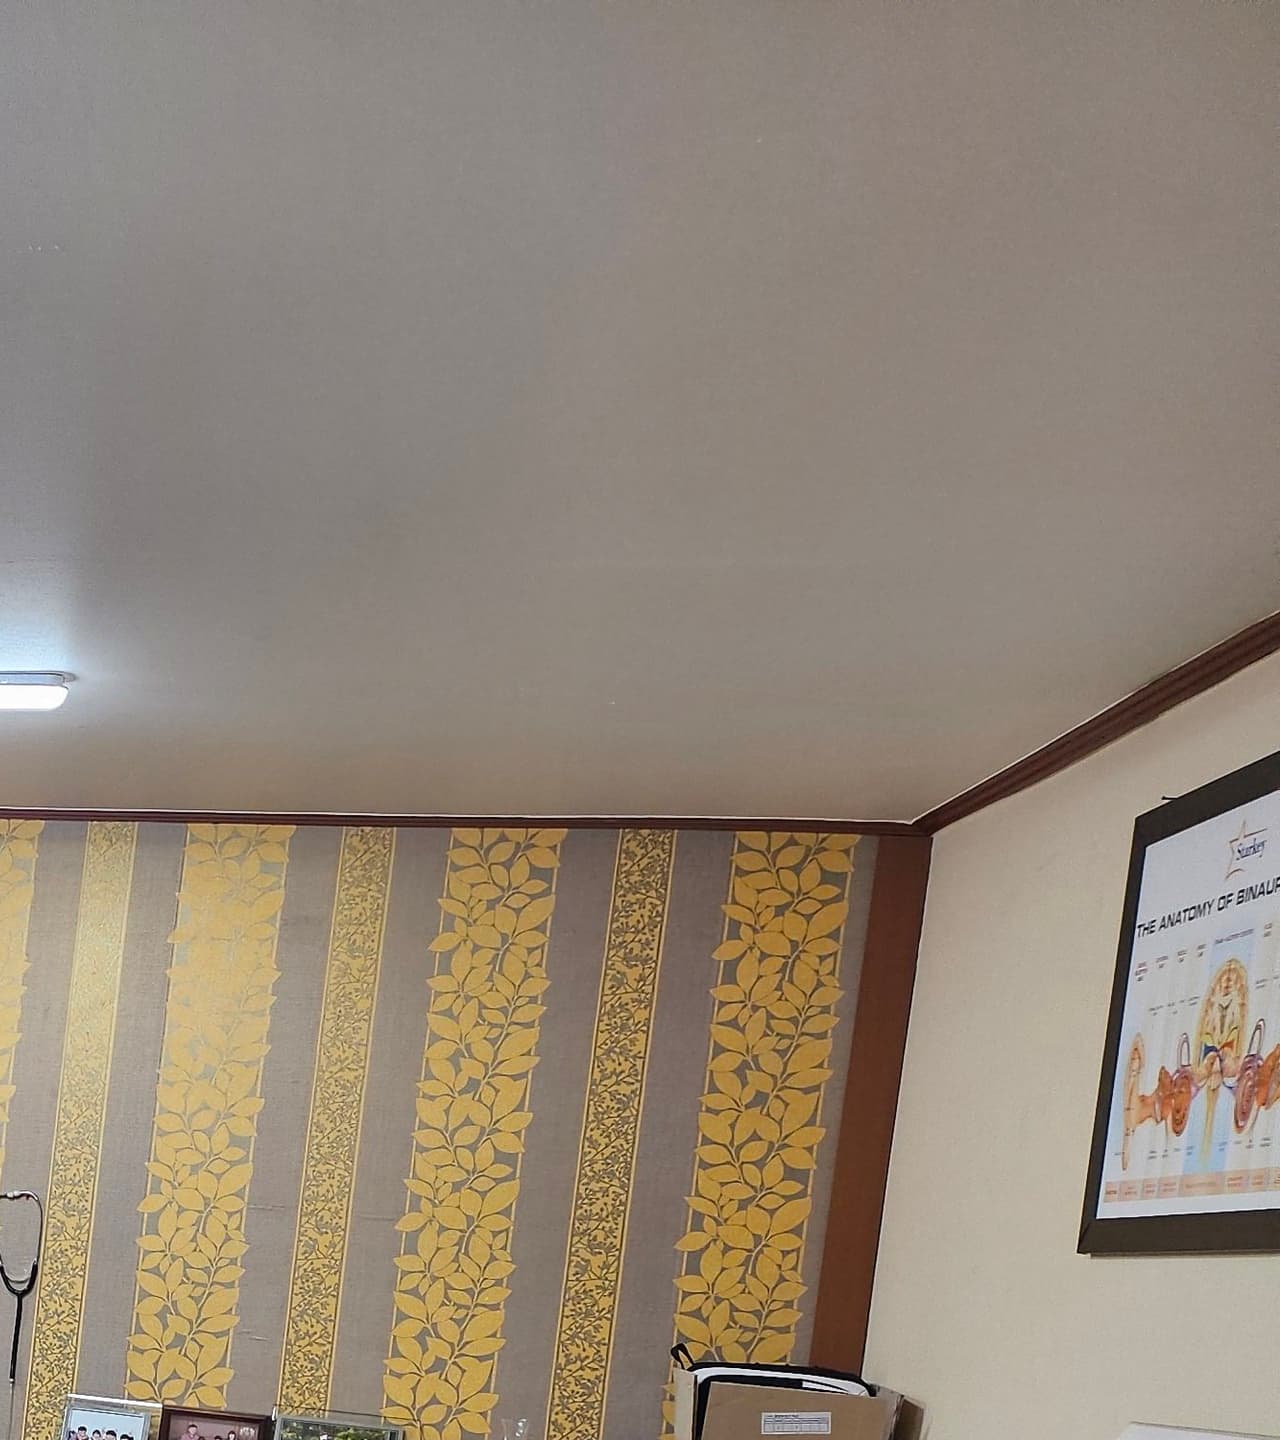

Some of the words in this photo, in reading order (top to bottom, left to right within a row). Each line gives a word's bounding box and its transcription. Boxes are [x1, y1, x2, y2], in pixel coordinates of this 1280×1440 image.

[1137, 919, 1157, 937] THE
[1158, 899, 1215, 932] ANATOMY
[1217, 892, 1234, 912] OF
